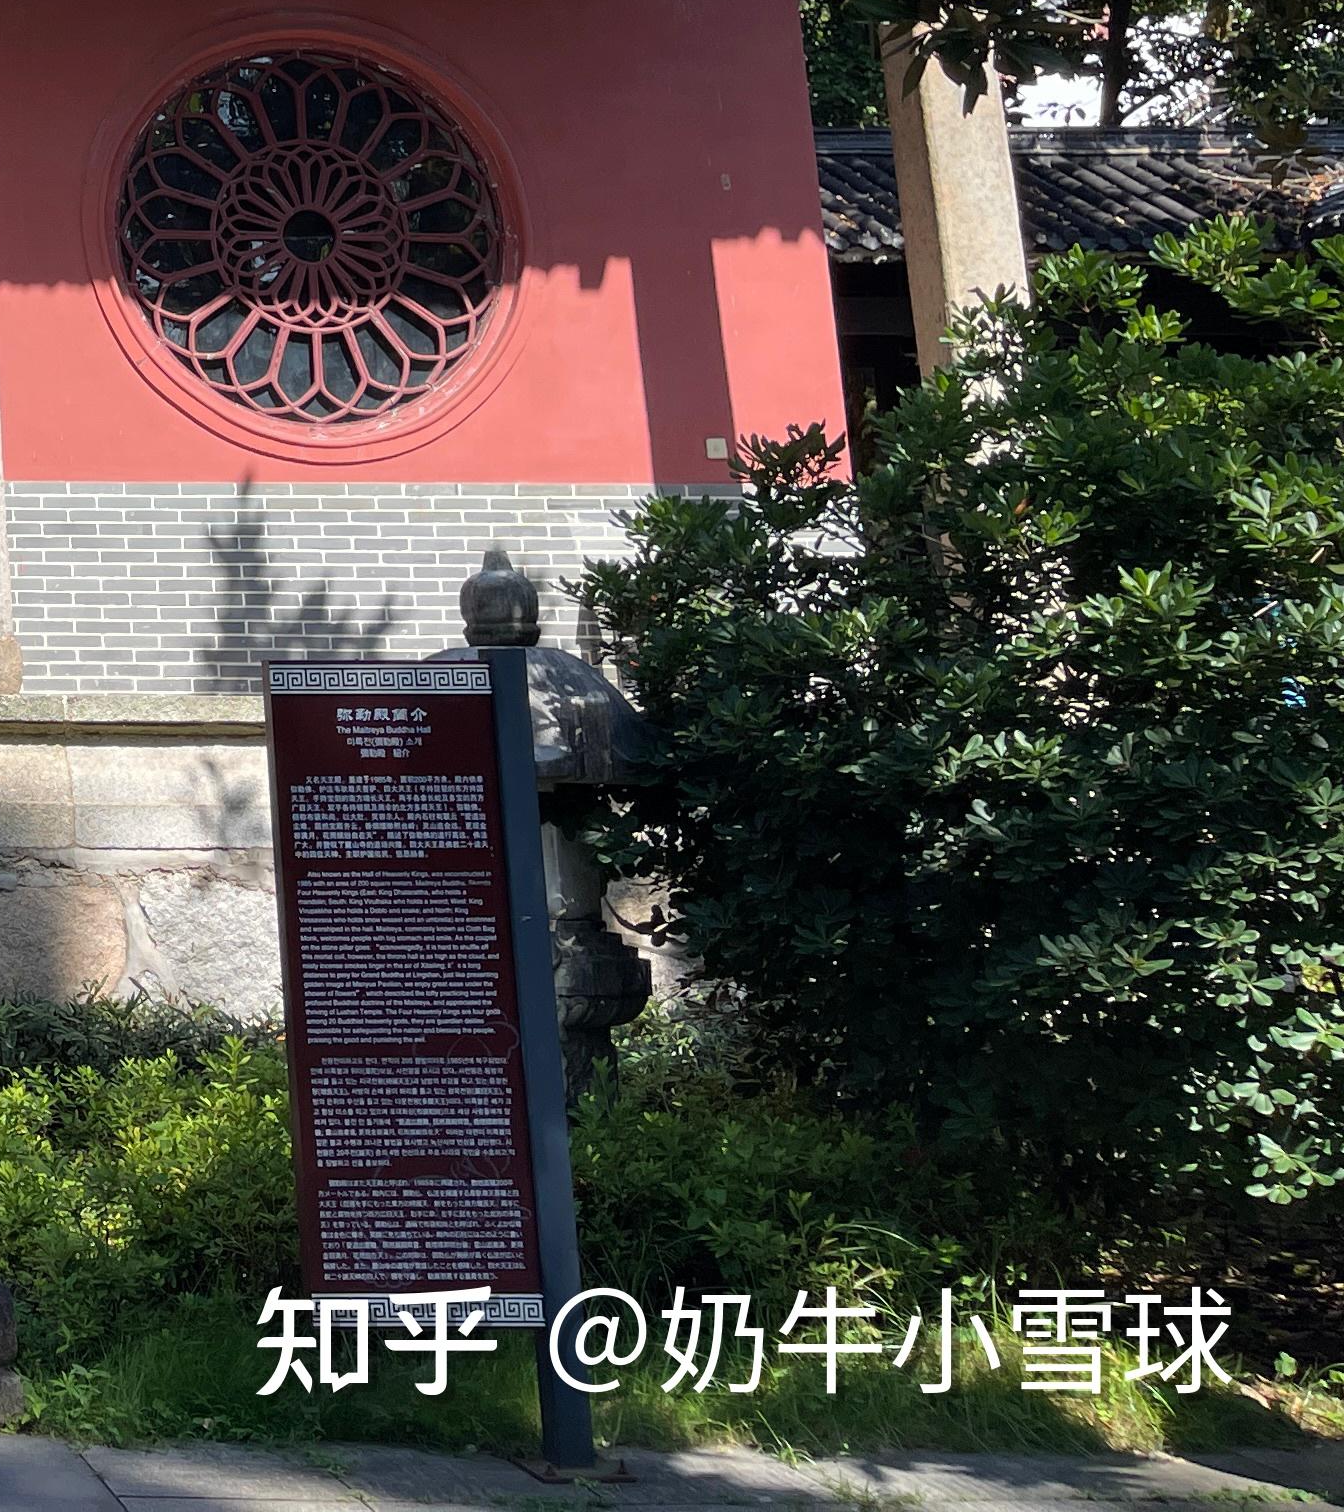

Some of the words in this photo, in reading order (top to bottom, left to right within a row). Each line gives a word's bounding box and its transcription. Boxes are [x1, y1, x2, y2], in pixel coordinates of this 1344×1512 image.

[336, 726, 351, 734] The
[386, 726, 415, 734] Buddha
[417, 726, 432, 734] Hall
